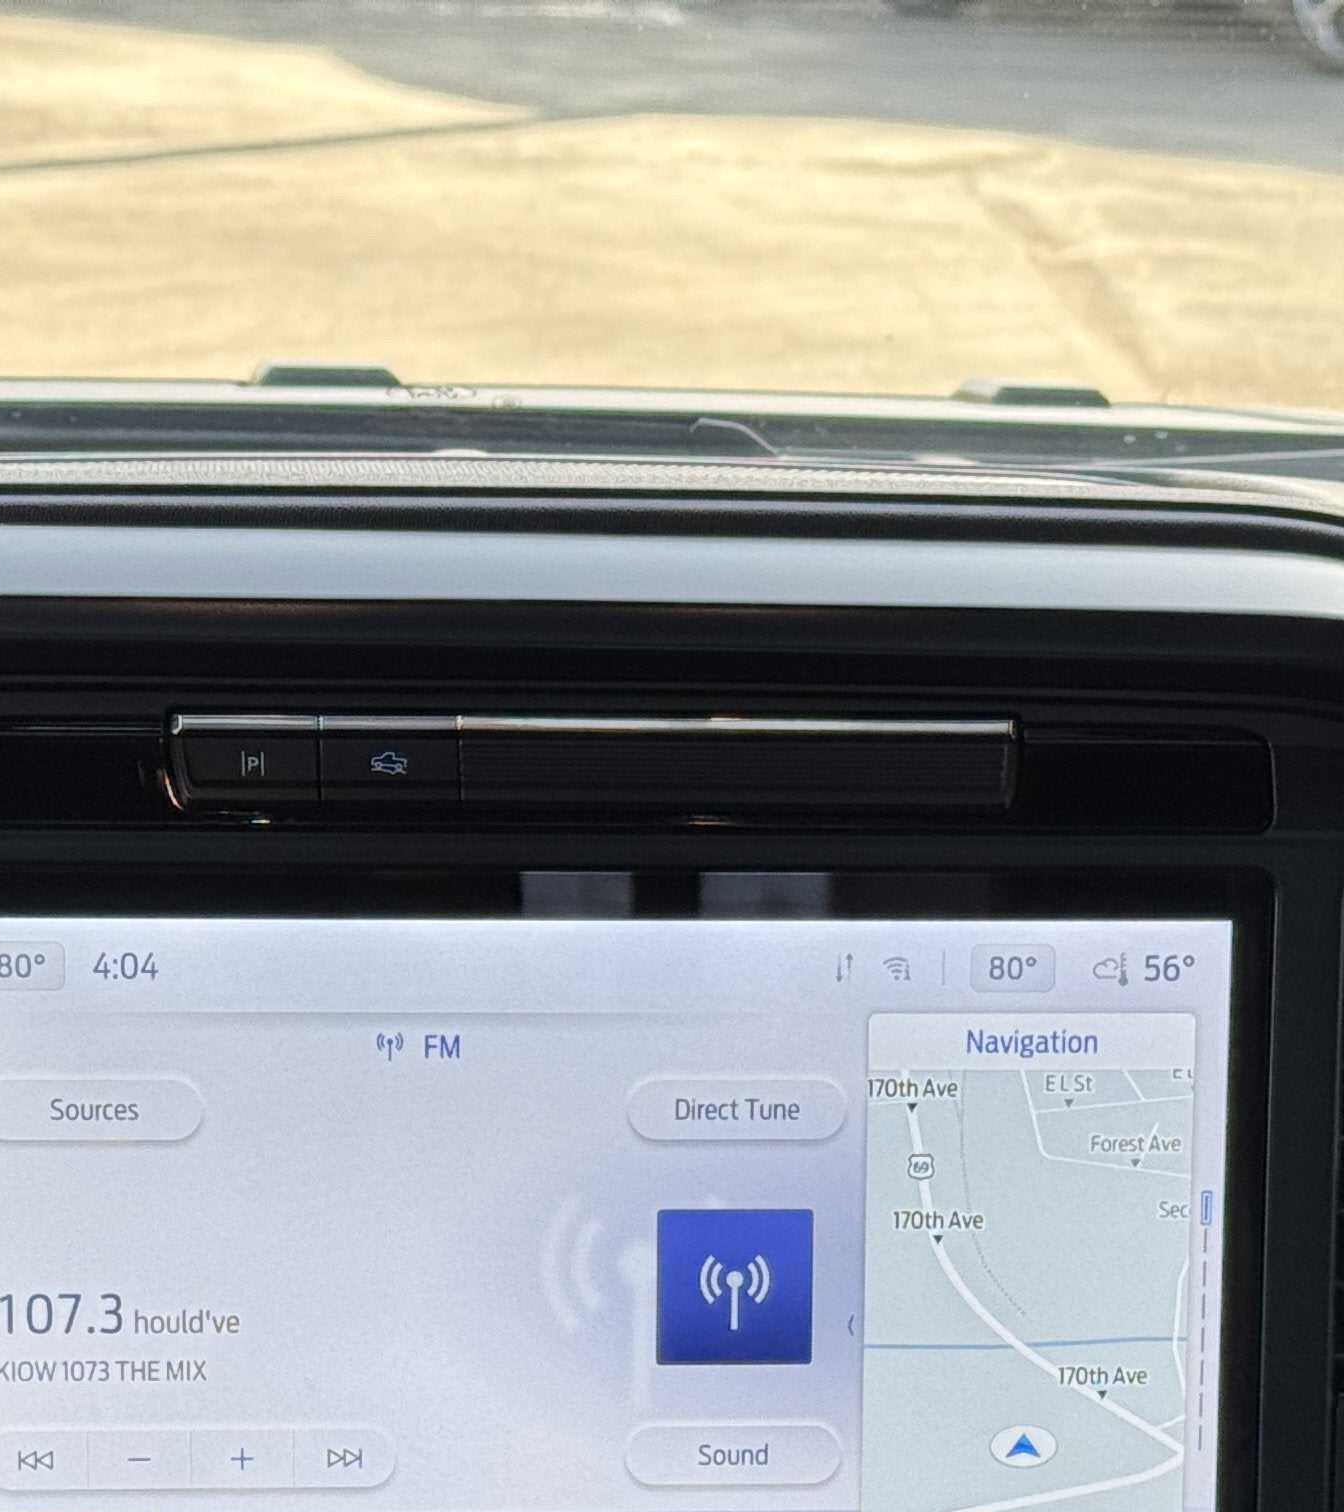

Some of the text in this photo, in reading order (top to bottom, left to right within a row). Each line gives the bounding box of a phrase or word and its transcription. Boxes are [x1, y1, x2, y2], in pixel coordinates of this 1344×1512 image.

[92, 951, 159, 981] 4:04
[989, 955, 1038, 981] 80°
[1143, 954, 1196, 982] 56°
[424, 1034, 462, 1059] FM
[966, 1029, 1099, 1059] Navigation
[867, 1077, 959, 1099] 170th Ave
[49, 1098, 140, 1123] Sources
[674, 1097, 801, 1122] Direct Tune
[1090, 1134, 1182, 1152] Forest Ave
[893, 1209, 985, 1231] 170th Ave
[1158, 1201, 1192, 1219] Sec
[133, 1308, 241, 1336] hould've
[60, 1360, 111, 1382] 1073
[115, 1360, 161, 1382] THE
[164, 1359, 208, 1382] MIX
[1057, 1365, 1148, 1387] 170th Ave
[697, 1442, 769, 1468] Sound
